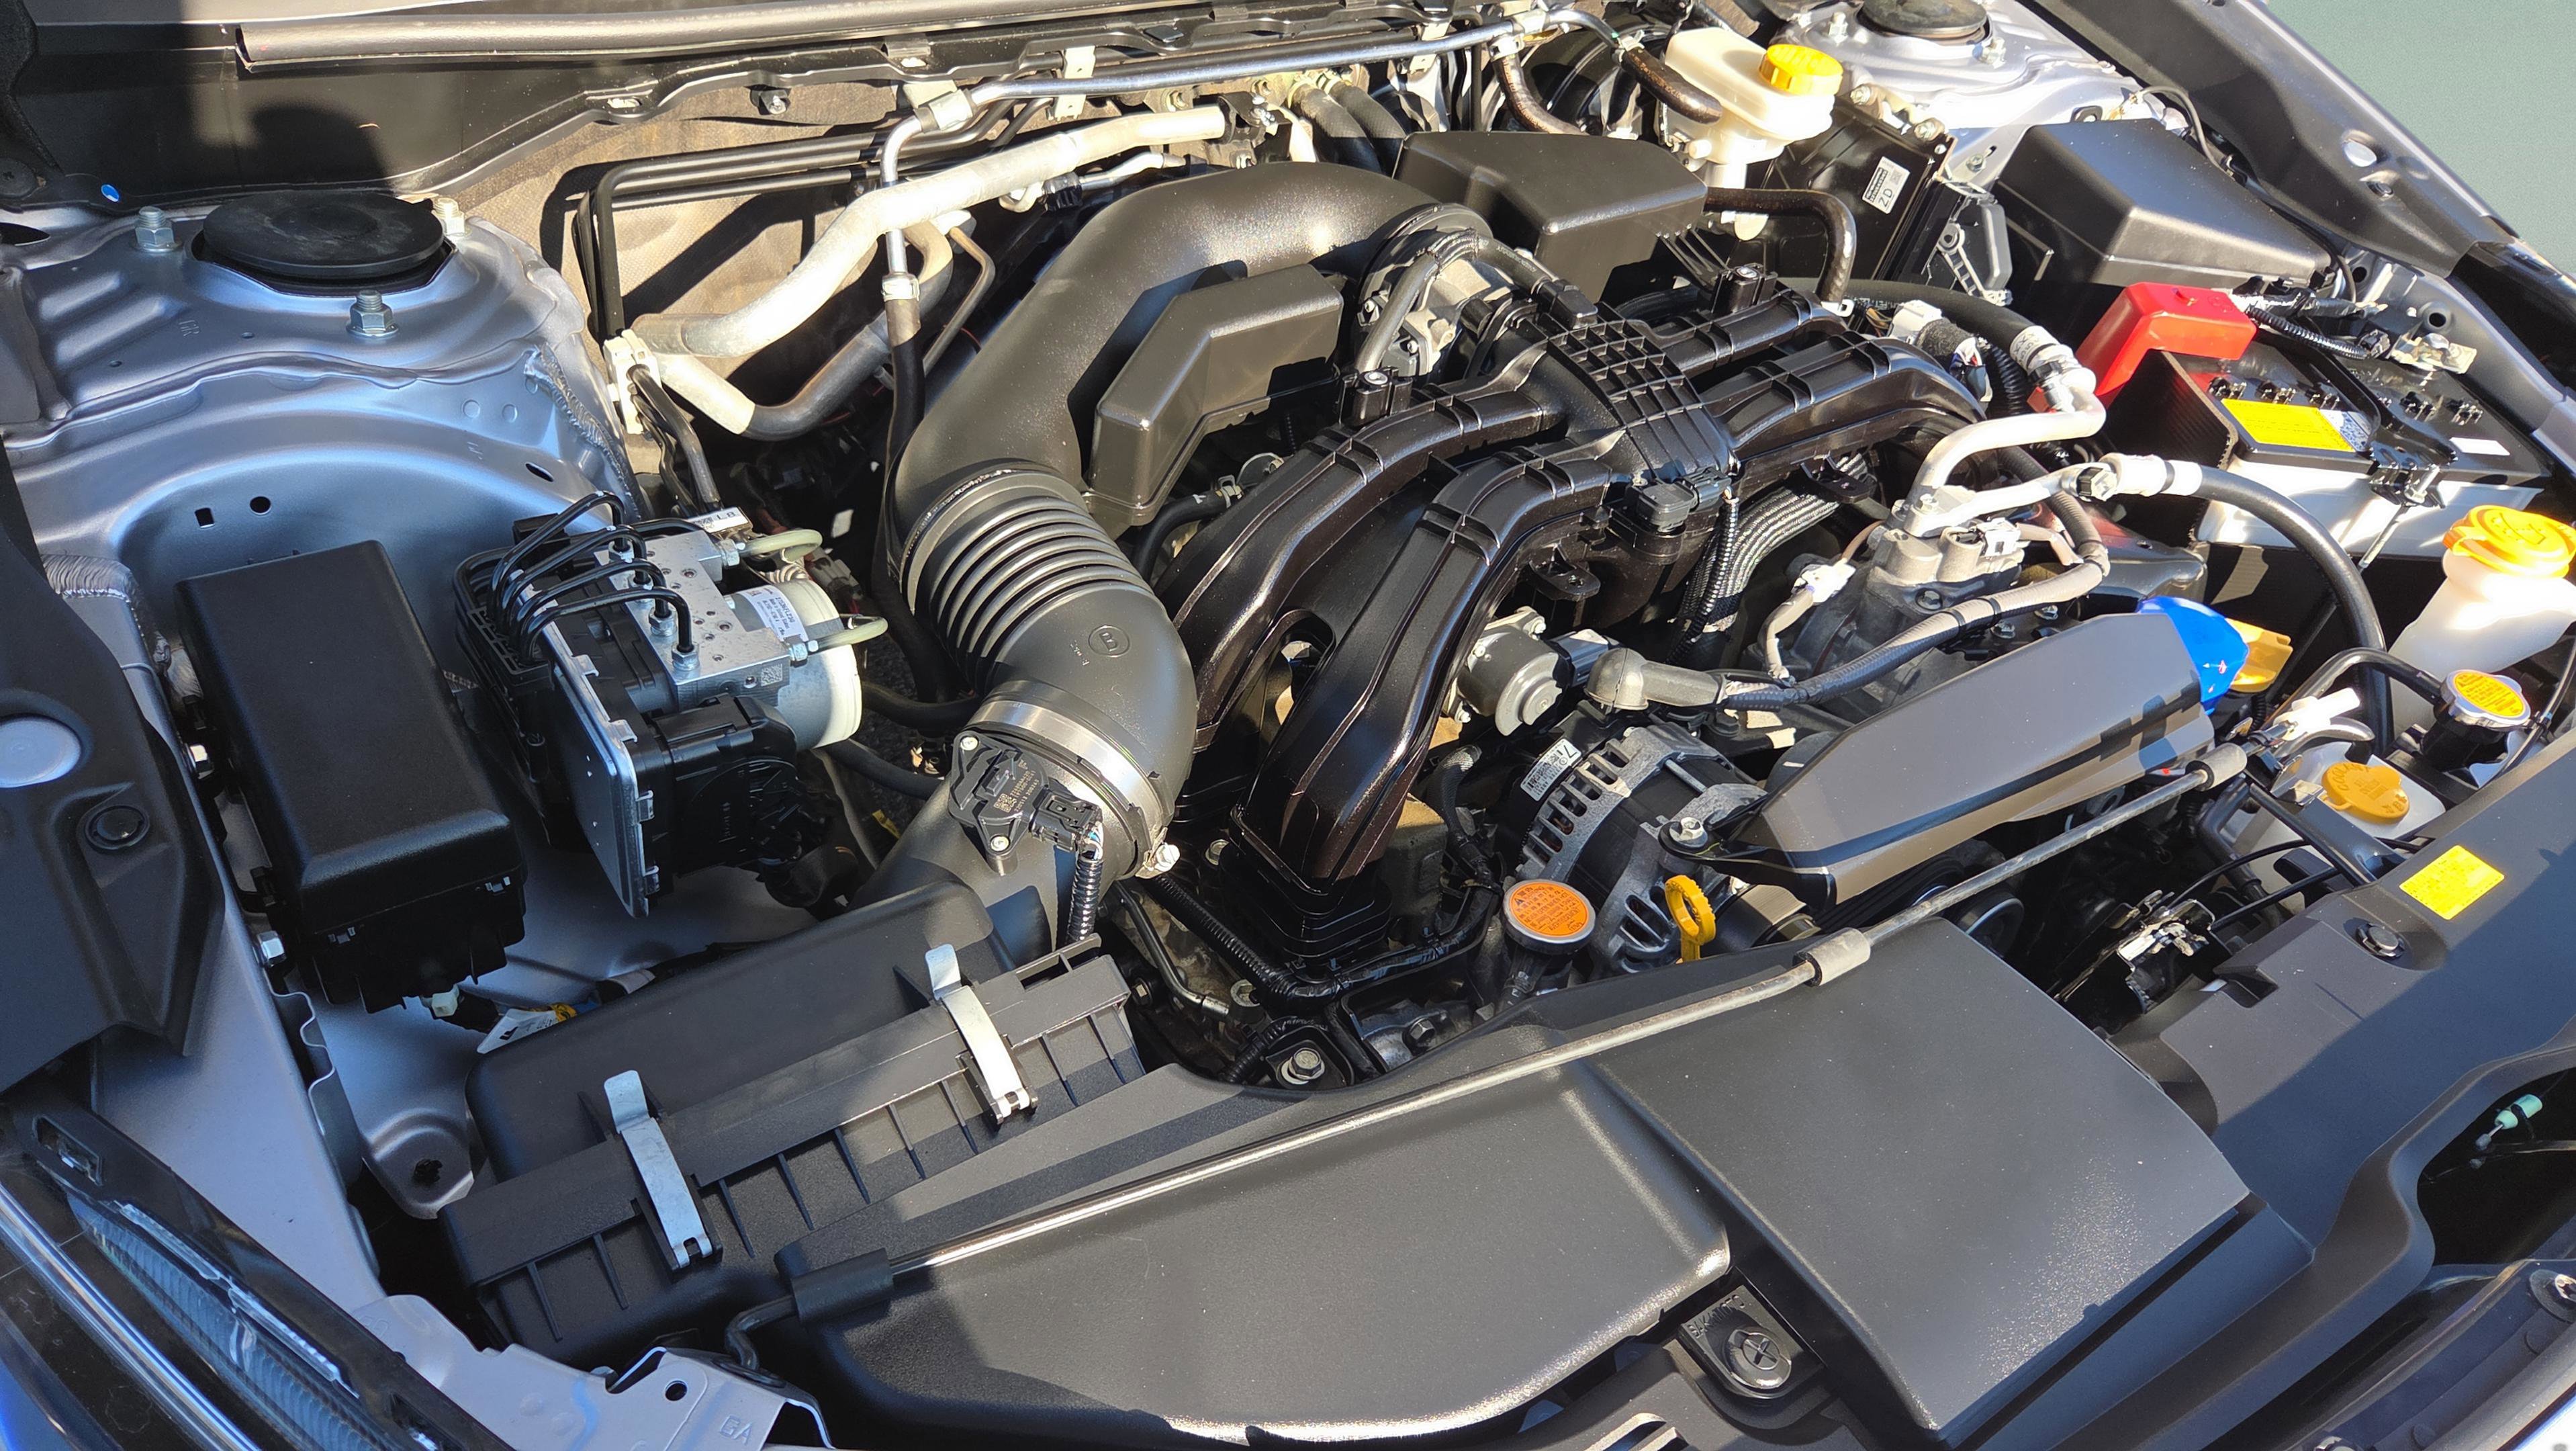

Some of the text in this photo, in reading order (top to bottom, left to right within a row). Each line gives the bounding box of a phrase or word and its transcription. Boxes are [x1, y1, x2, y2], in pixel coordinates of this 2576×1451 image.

[1878, 188, 1893, 207] ZD
[1099, 632, 1118, 652] B
[1687, 1294, 1746, 1339] SAKAMOTO
